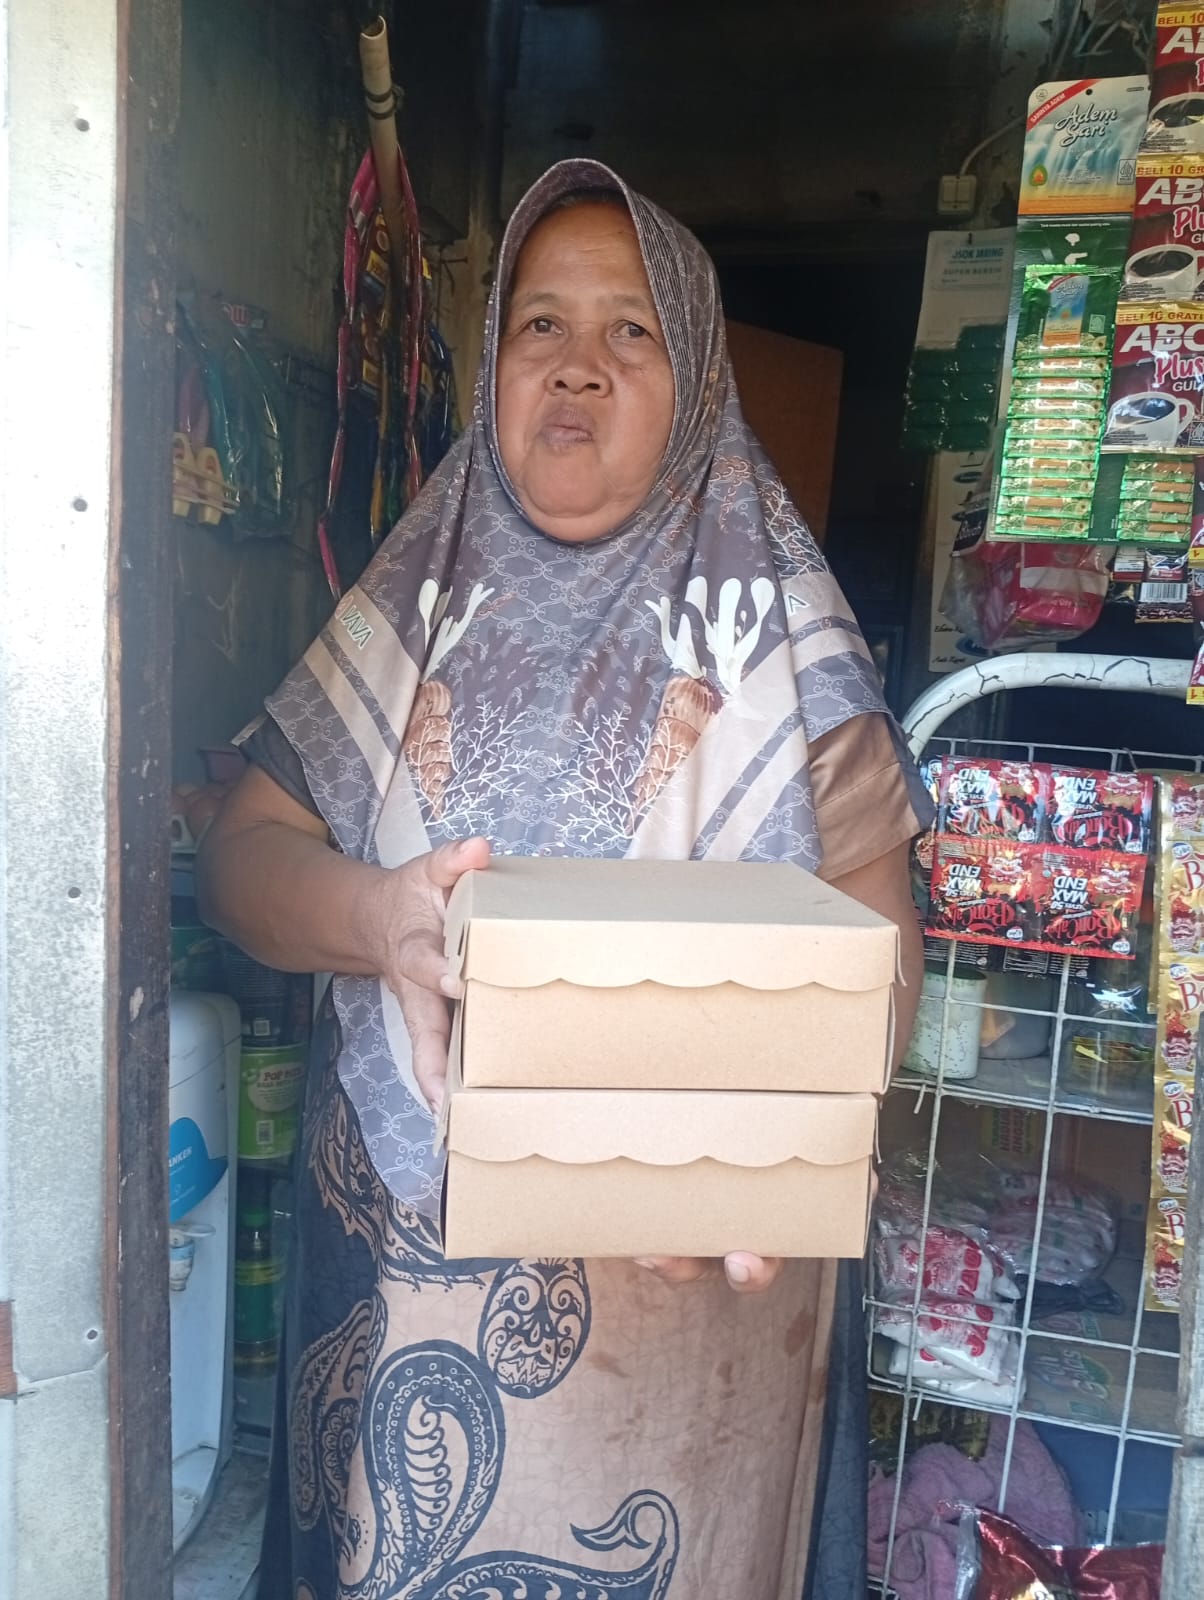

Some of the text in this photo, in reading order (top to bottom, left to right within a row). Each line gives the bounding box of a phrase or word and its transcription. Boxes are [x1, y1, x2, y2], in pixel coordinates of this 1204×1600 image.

[1158, 16, 1184, 25] BELI
[1055, 103, 1117, 131] Adem
[1060, 121, 1108, 148] Sari
[1137, 166, 1163, 175] BELI
[1169, 164, 1183, 175] 10
[1138, 177, 1204, 205] AB
[1118, 312, 1144, 322] BELI
[1148, 311, 1162, 321] 10
[1120, 323, 1204, 352] ABC
[1153, 352, 1204, 388] Plus
[958, 768, 990, 781] END
[1065, 777, 1097, 790] END
[949, 864, 981, 878] END
[946, 877, 982, 891] MAX
[1054, 876, 1088, 890] END
[1051, 889, 1088, 903] MAX
